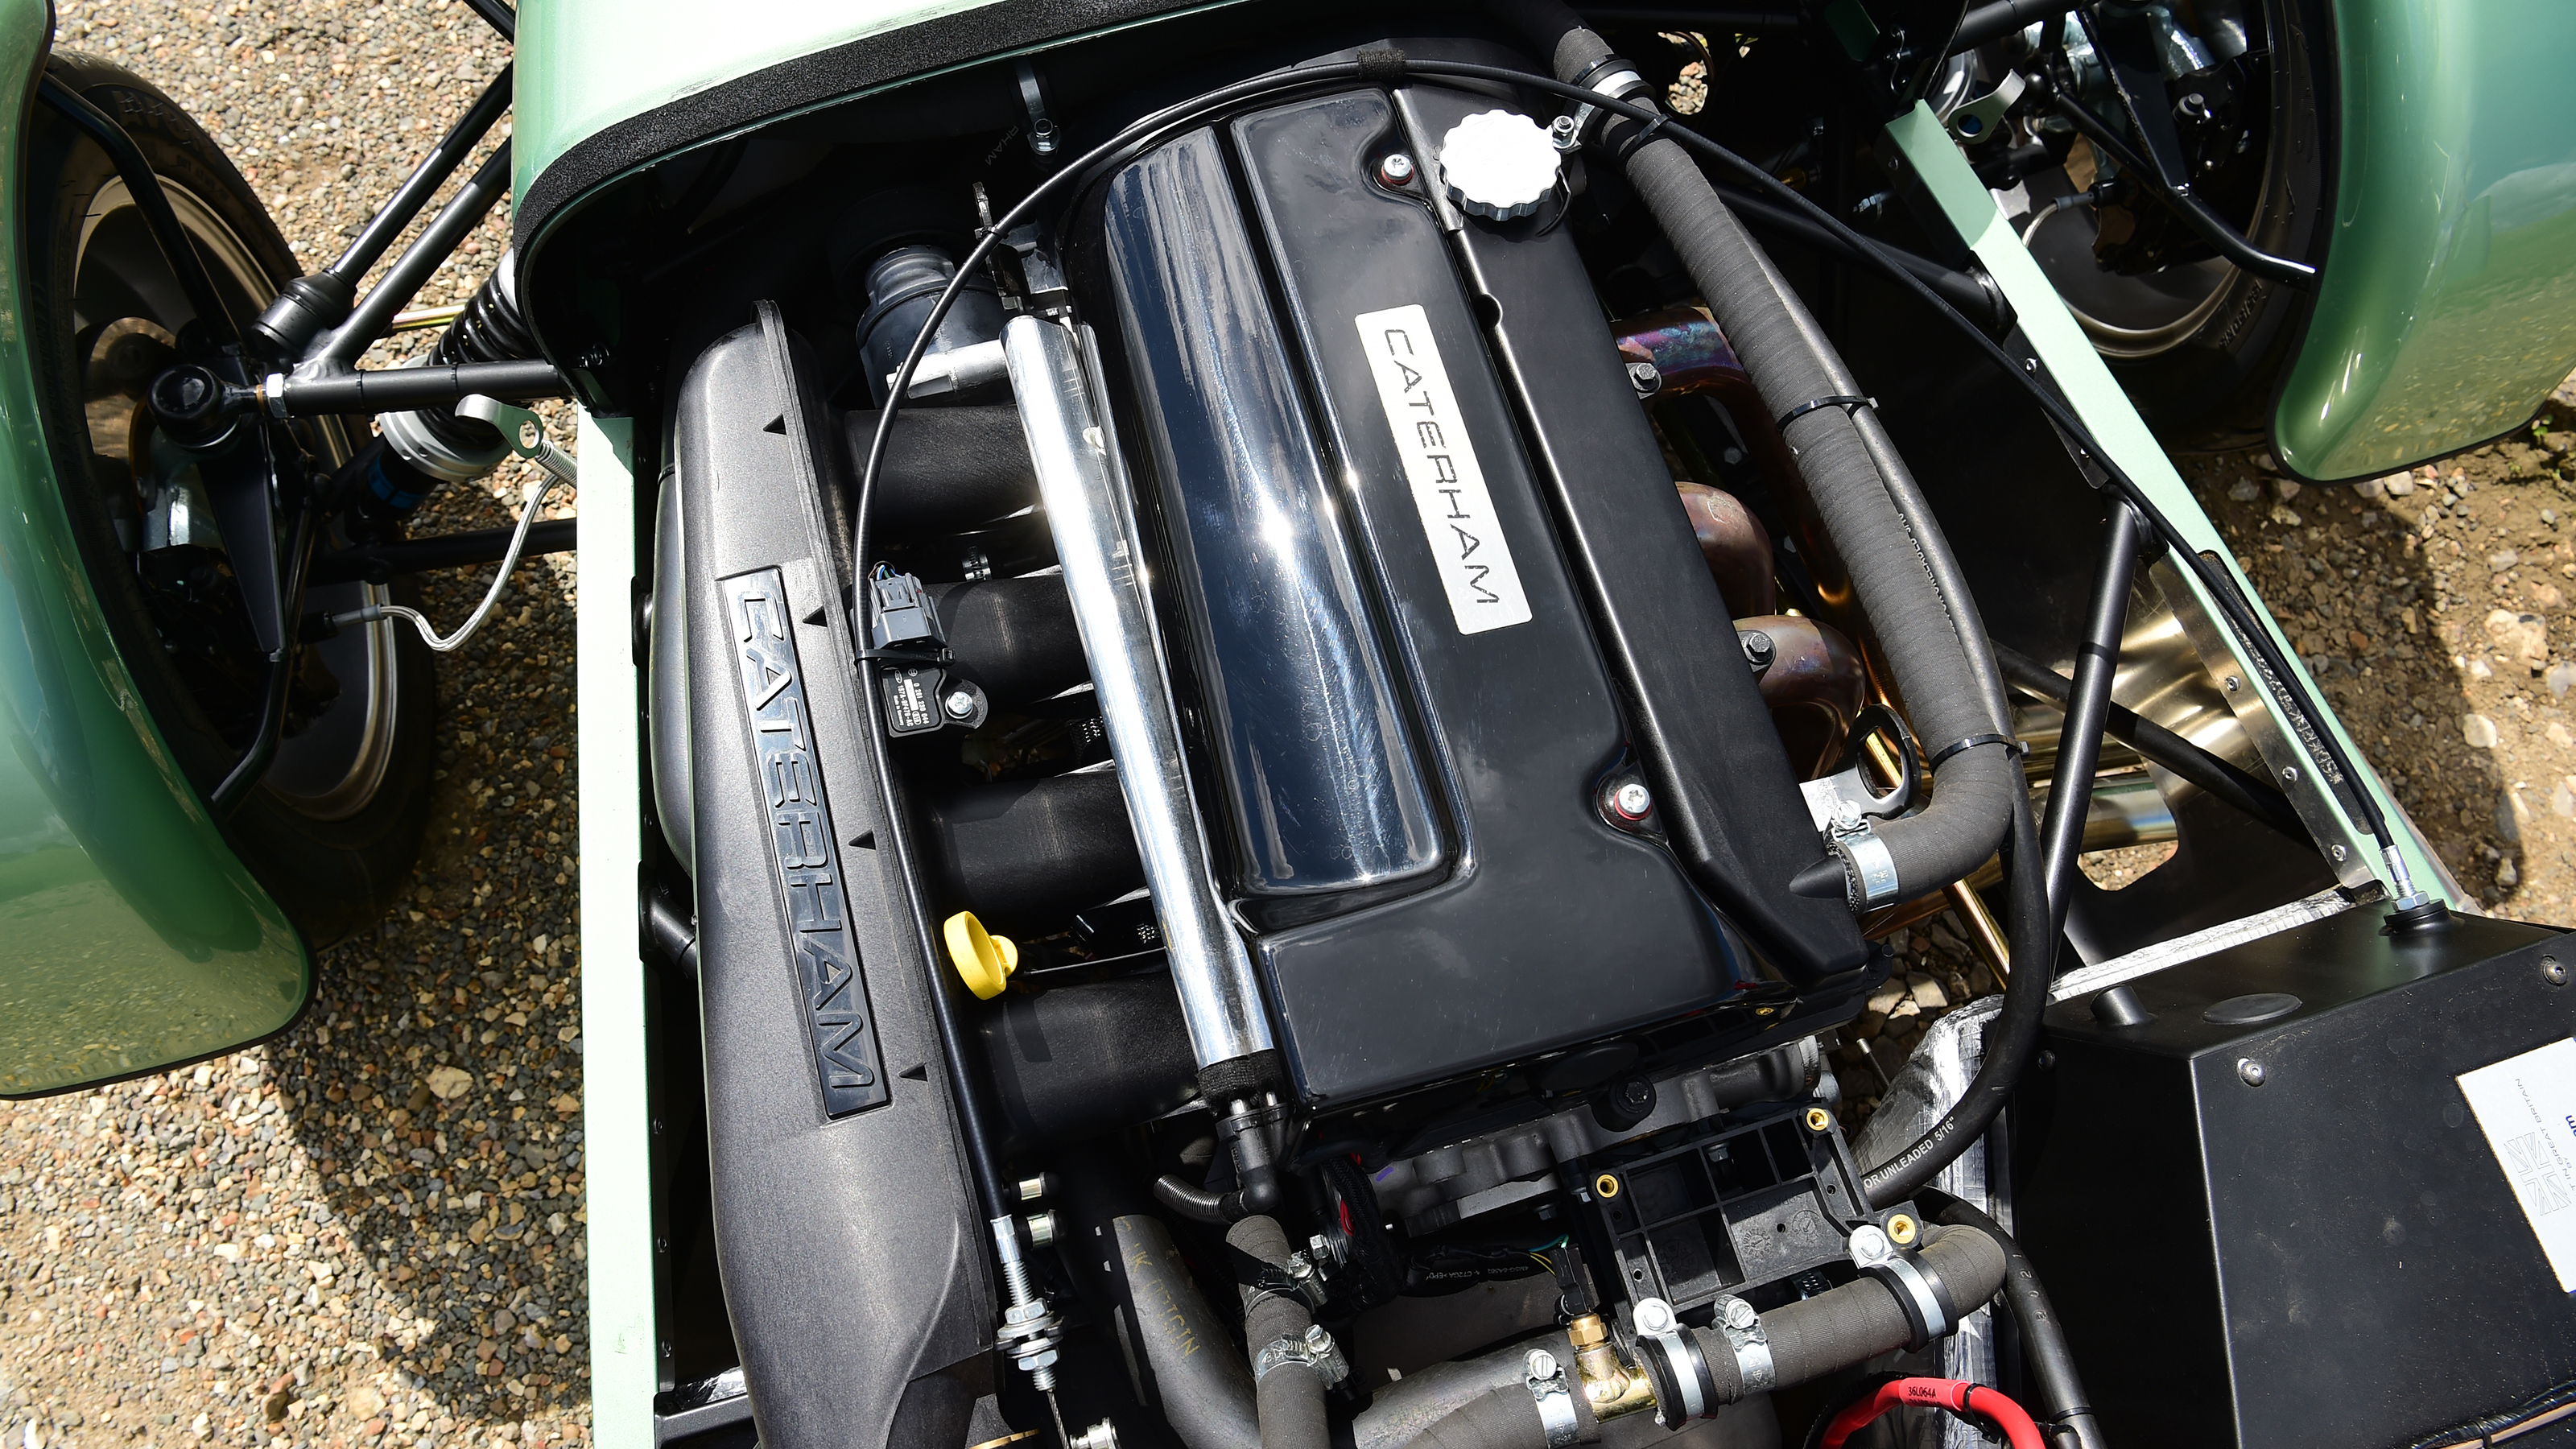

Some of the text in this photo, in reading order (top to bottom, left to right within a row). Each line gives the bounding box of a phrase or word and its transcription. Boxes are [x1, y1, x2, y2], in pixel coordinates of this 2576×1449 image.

[1385, 328, 1500, 603] CATERHAM
[921, 712, 930, 724] 044
[736, 589, 876, 1089] CATERHAM
[2515, 1079, 2542, 1123] BRITAIN
[1880, 1139, 1934, 1181] UNLEADED
[1934, 1117, 1955, 1142] 5/16"
[2540, 1128, 2563, 1166] GREAT
[1908, 1386, 1937, 1398] 36L064A
